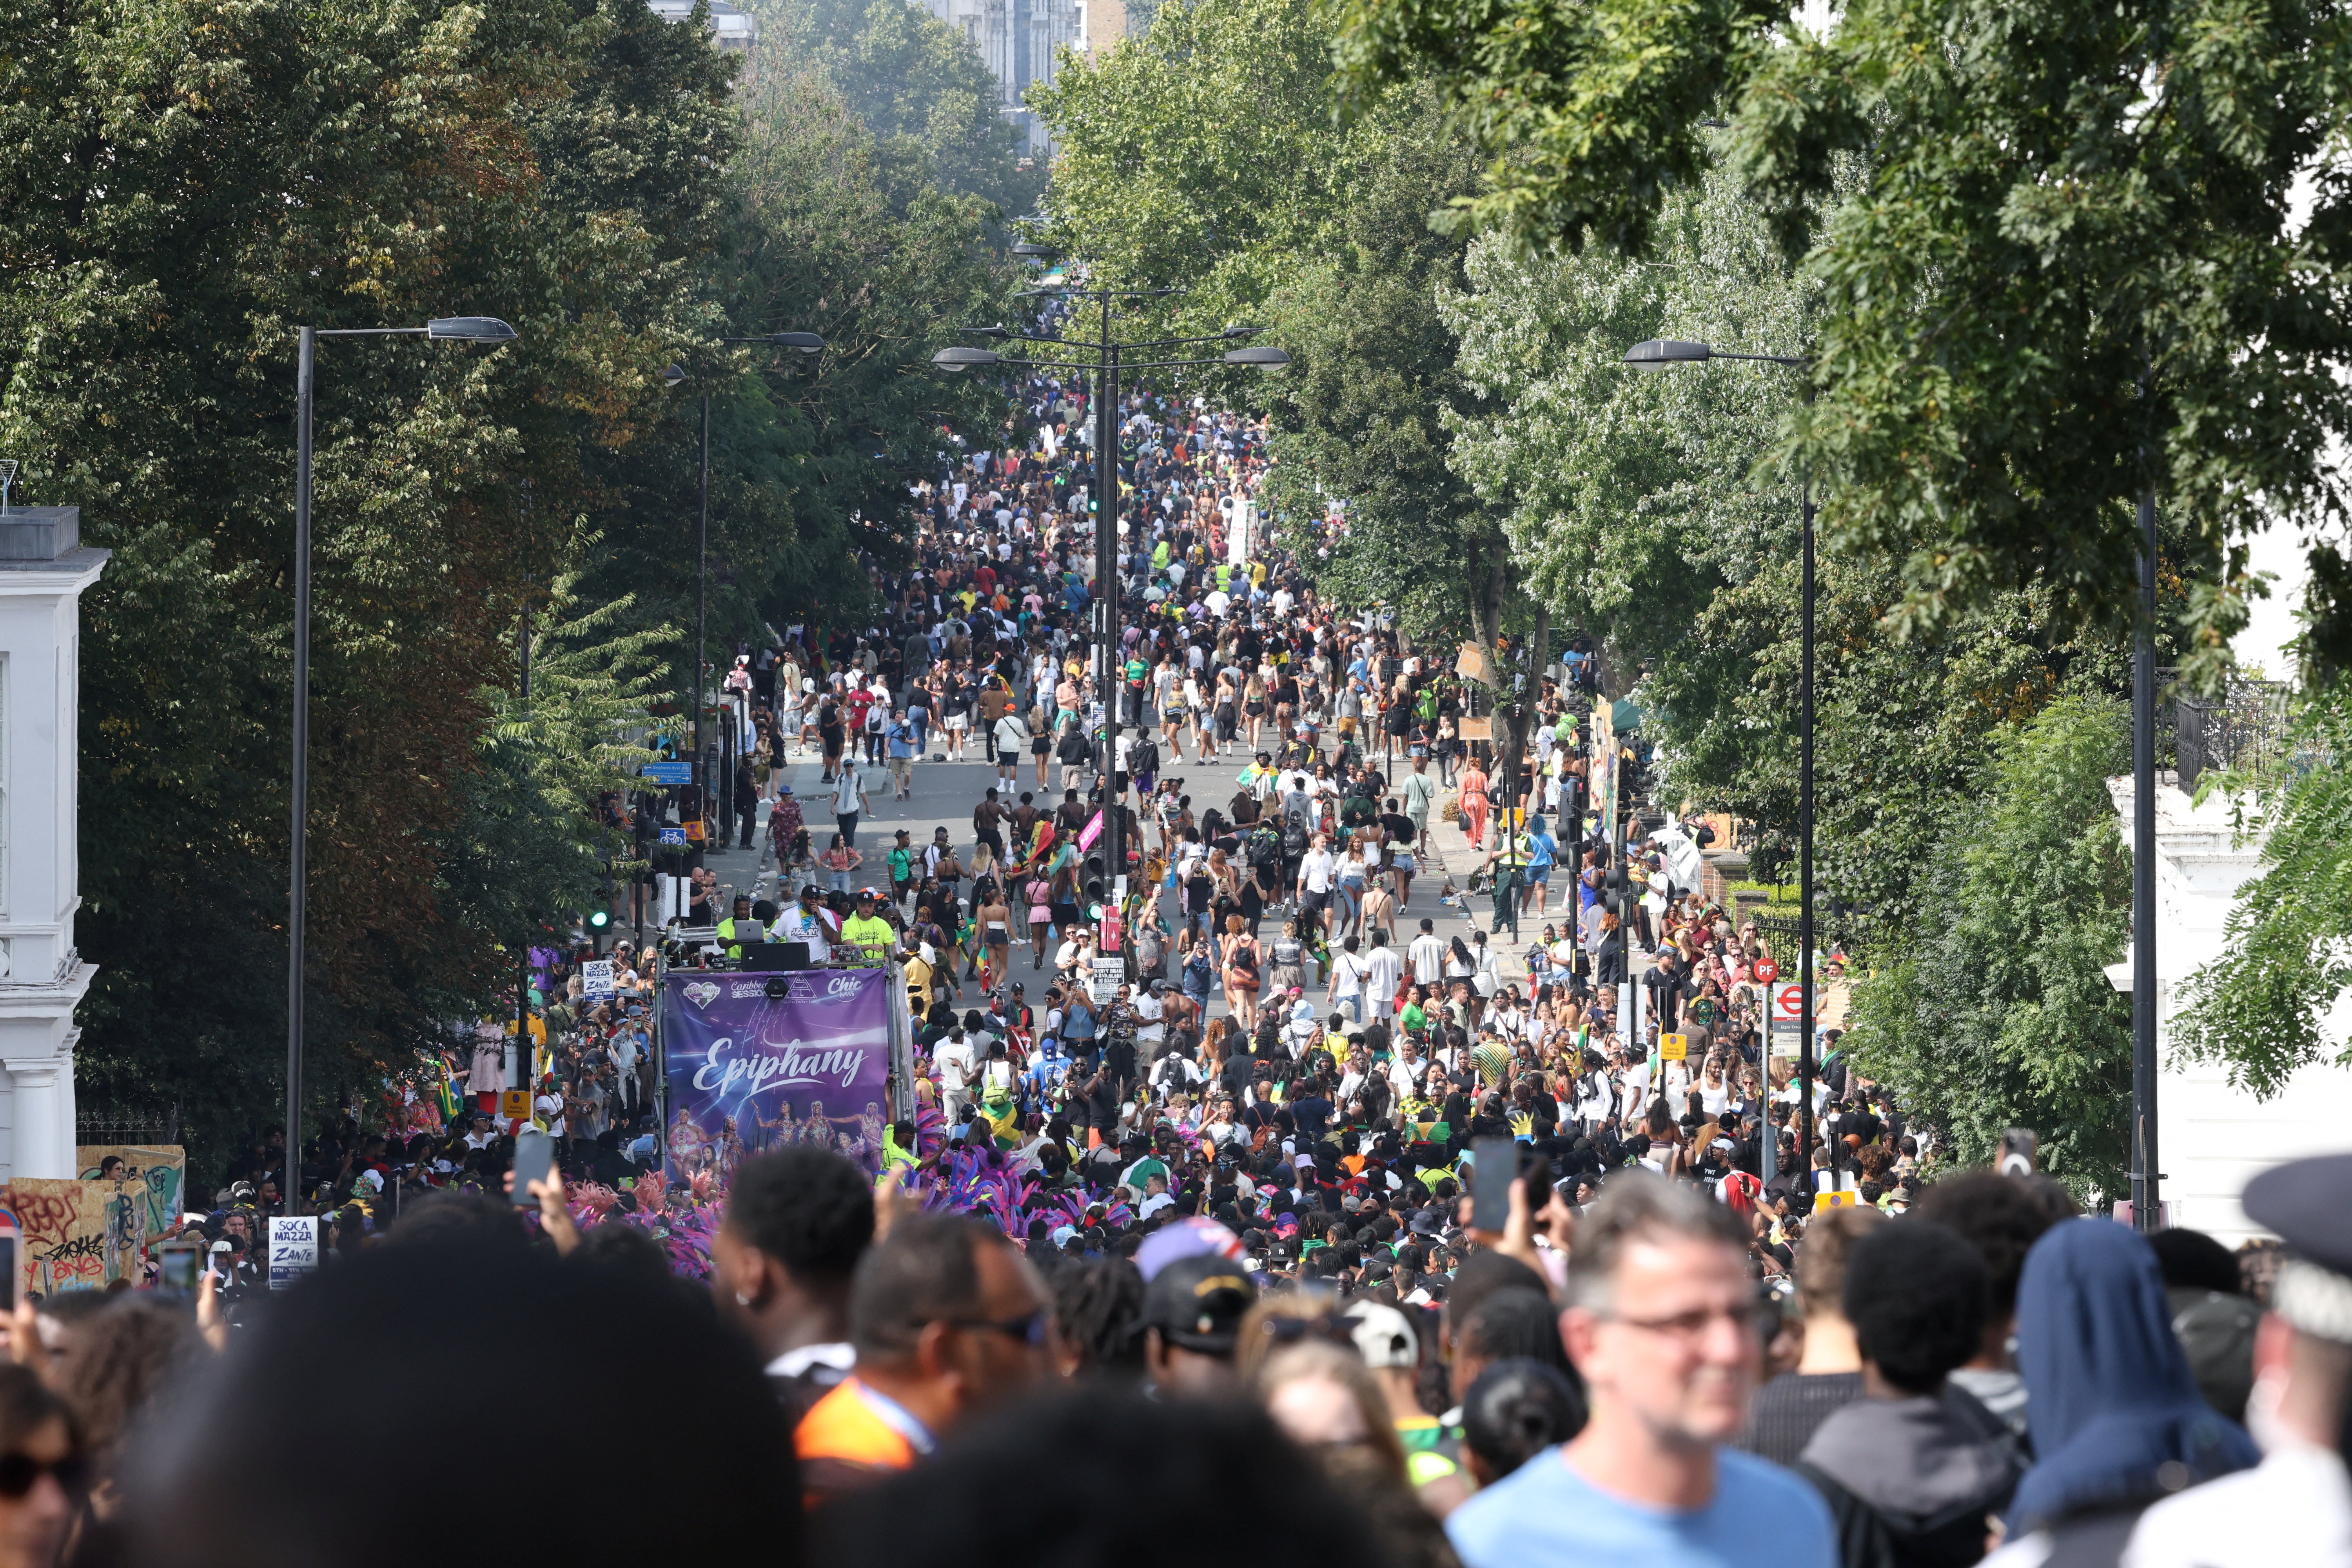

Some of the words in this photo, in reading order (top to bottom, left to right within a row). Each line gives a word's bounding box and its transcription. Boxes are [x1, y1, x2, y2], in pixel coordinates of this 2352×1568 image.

[1759, 965, 1773, 975] PF
[586, 981, 610, 990] ZANTE
[828, 976, 863, 994] Chic
[693, 1038, 869, 1098] Epiphany
[279, 1220, 309, 1231] SOCA
[275, 1232, 312, 1241] MAZZA
[273, 1247, 314, 1261] ZANTE
